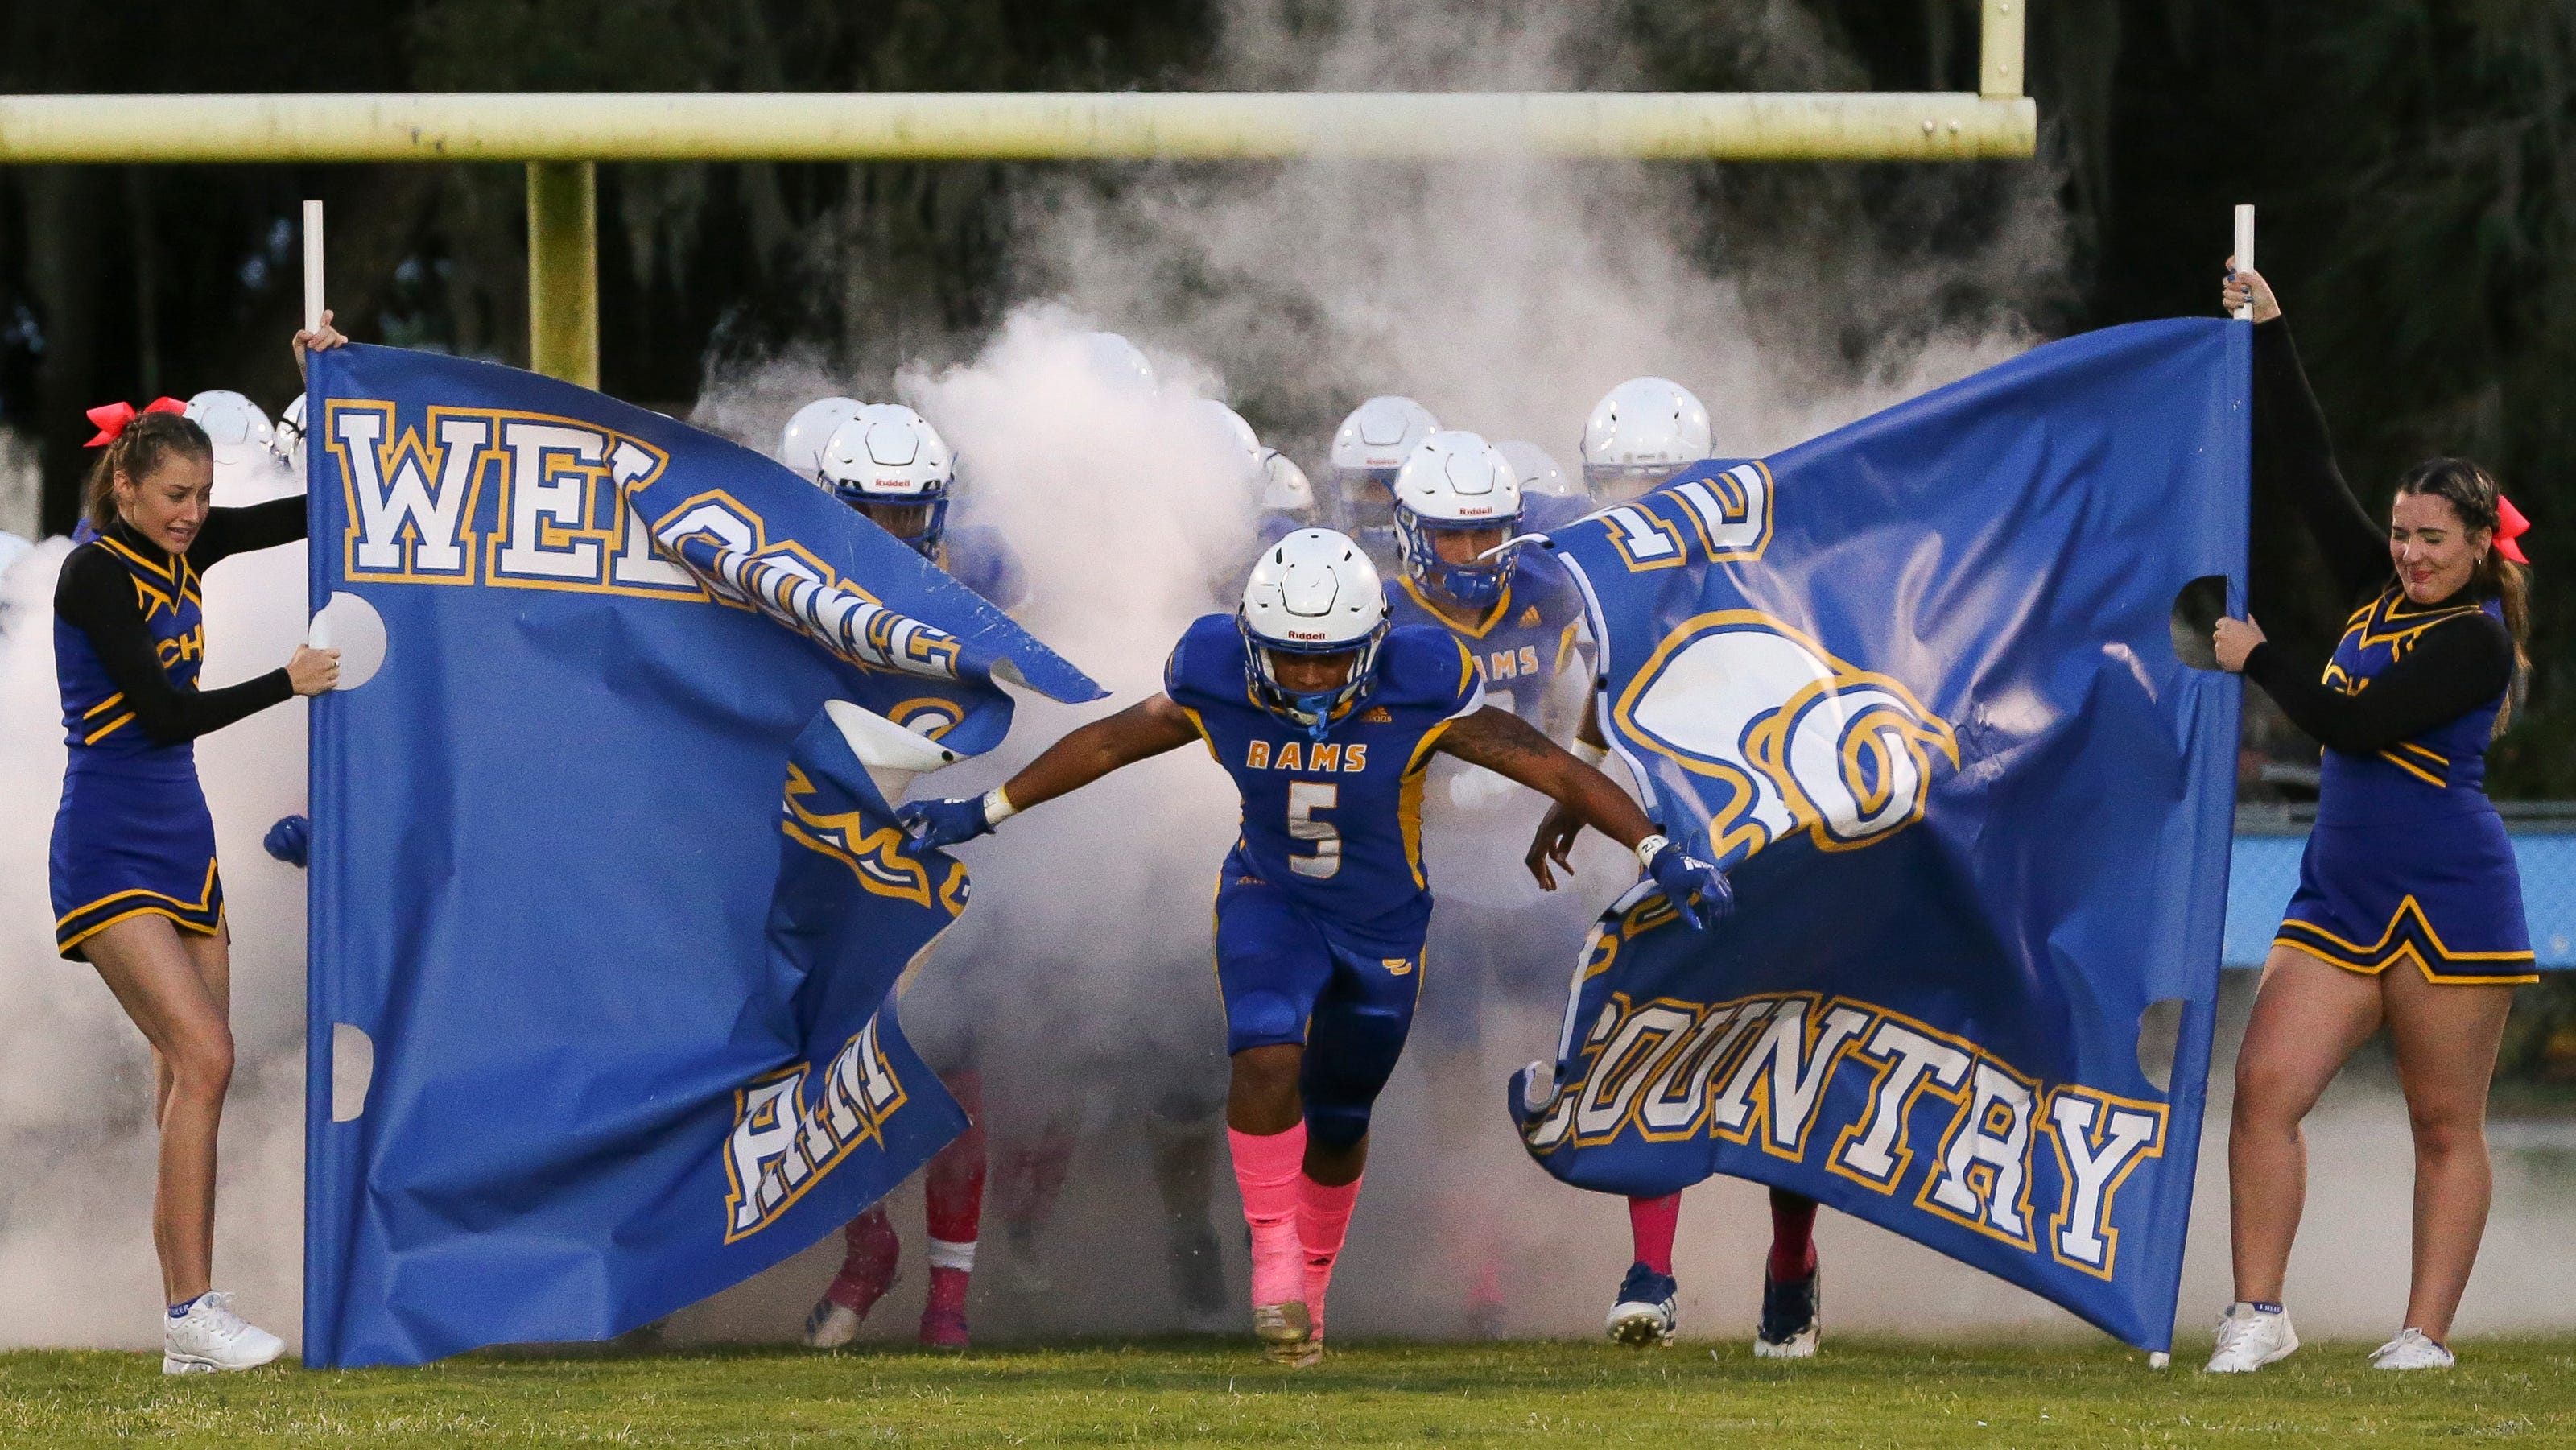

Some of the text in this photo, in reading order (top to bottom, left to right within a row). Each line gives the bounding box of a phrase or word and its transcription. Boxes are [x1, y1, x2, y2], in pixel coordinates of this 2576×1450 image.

[156, 623, 204, 668] CH
[1288, 630, 1326, 640] Riddell
[1246, 740, 1368, 772] RAMS
[1288, 779, 1341, 879] 5
